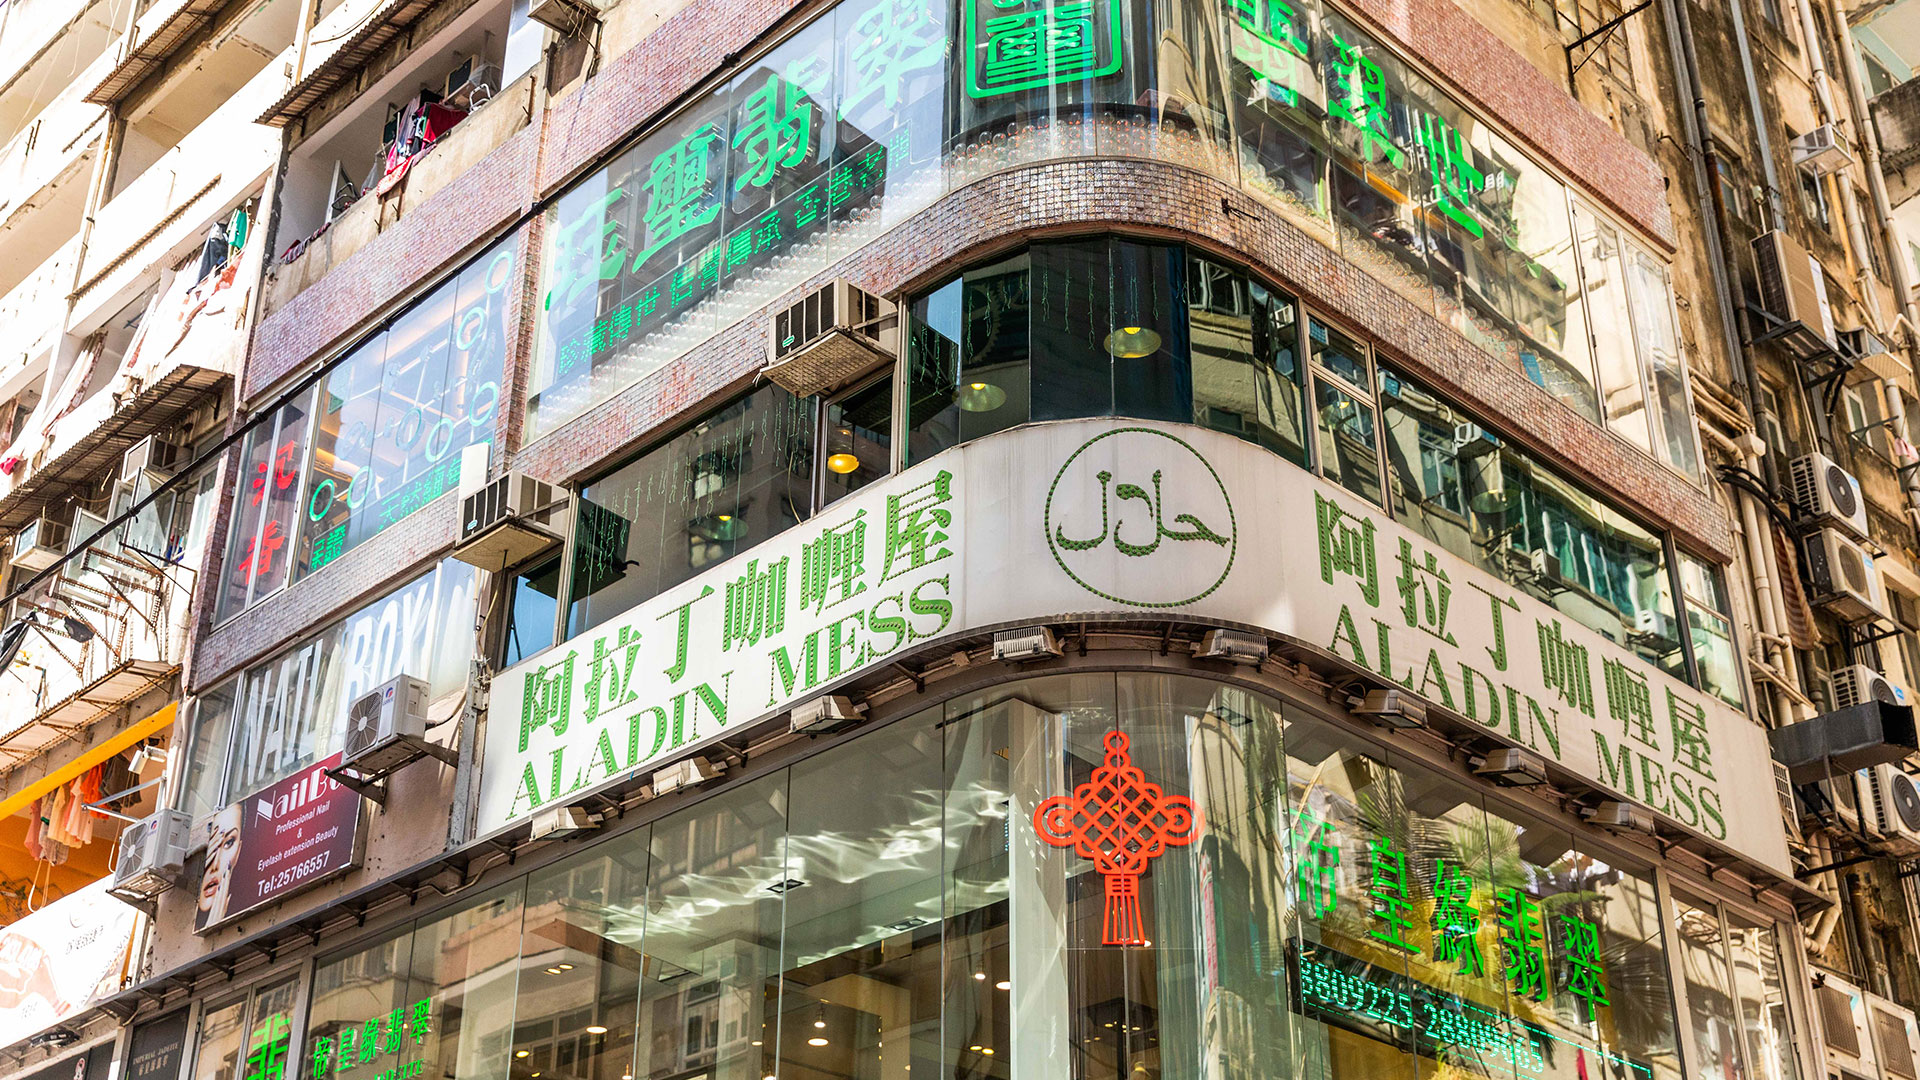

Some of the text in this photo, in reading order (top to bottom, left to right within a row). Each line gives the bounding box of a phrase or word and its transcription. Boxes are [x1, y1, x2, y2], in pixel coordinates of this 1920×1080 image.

[1055, 468, 1231, 557] حلال
[517, 469, 953, 754] 阿拉丁咖喱屋
[1313, 489, 1718, 783] 阿拉丁咖喱屋
[236, 639, 324, 793] NAIL
[505, 573, 953, 820] ALADIN MESS
[1326, 604, 1727, 841] ALADIN MESS
[257, 825, 339, 872] Eyelash extension Beauty
[257, 850, 331, 897] Tel:25766557
[275, 800, 331, 836] Professional Nail
